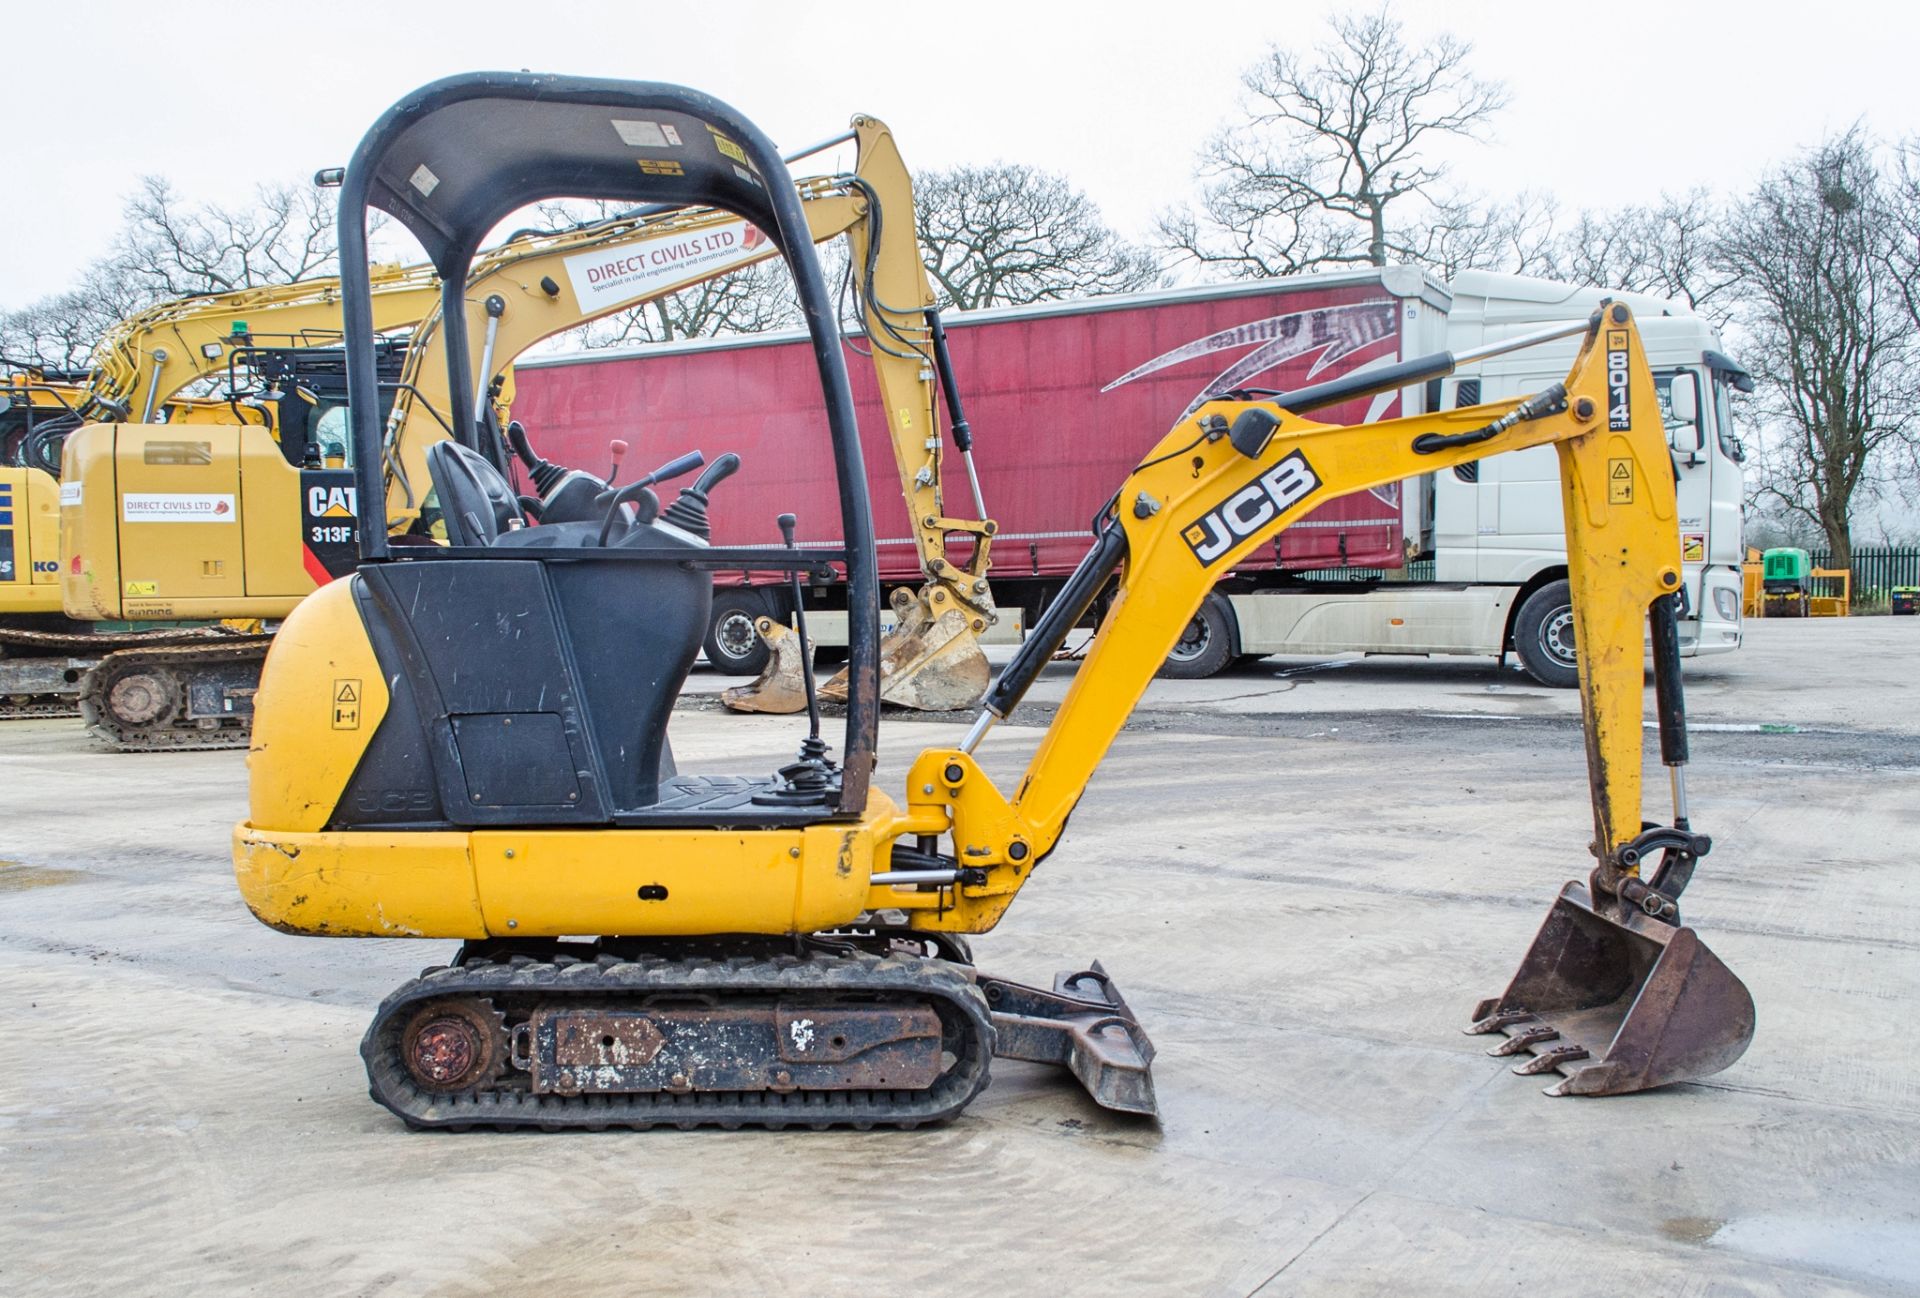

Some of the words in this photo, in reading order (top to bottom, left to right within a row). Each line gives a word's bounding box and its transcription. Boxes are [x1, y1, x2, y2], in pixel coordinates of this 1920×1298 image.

[586, 254, 646, 284] DIRECT
[651, 239, 701, 265] CIVILS
[705, 231, 735, 251] LTD
[592, 279, 624, 293] Specialist
[624, 277, 631, 285] in
[632, 273, 646, 283] civil
[646, 262, 685, 277] engineering
[686, 258, 698, 267] and
[699, 247, 739, 263] construction
[1608, 351, 1629, 422] 8014
[126, 501, 160, 510] DIRECT
[163, 501, 192, 510] CIVILS
[194, 501, 212, 510] LTD
[308, 486, 358, 517] CAT
[1196, 457, 1316, 561] JCB
[312, 526, 351, 543] 313F
